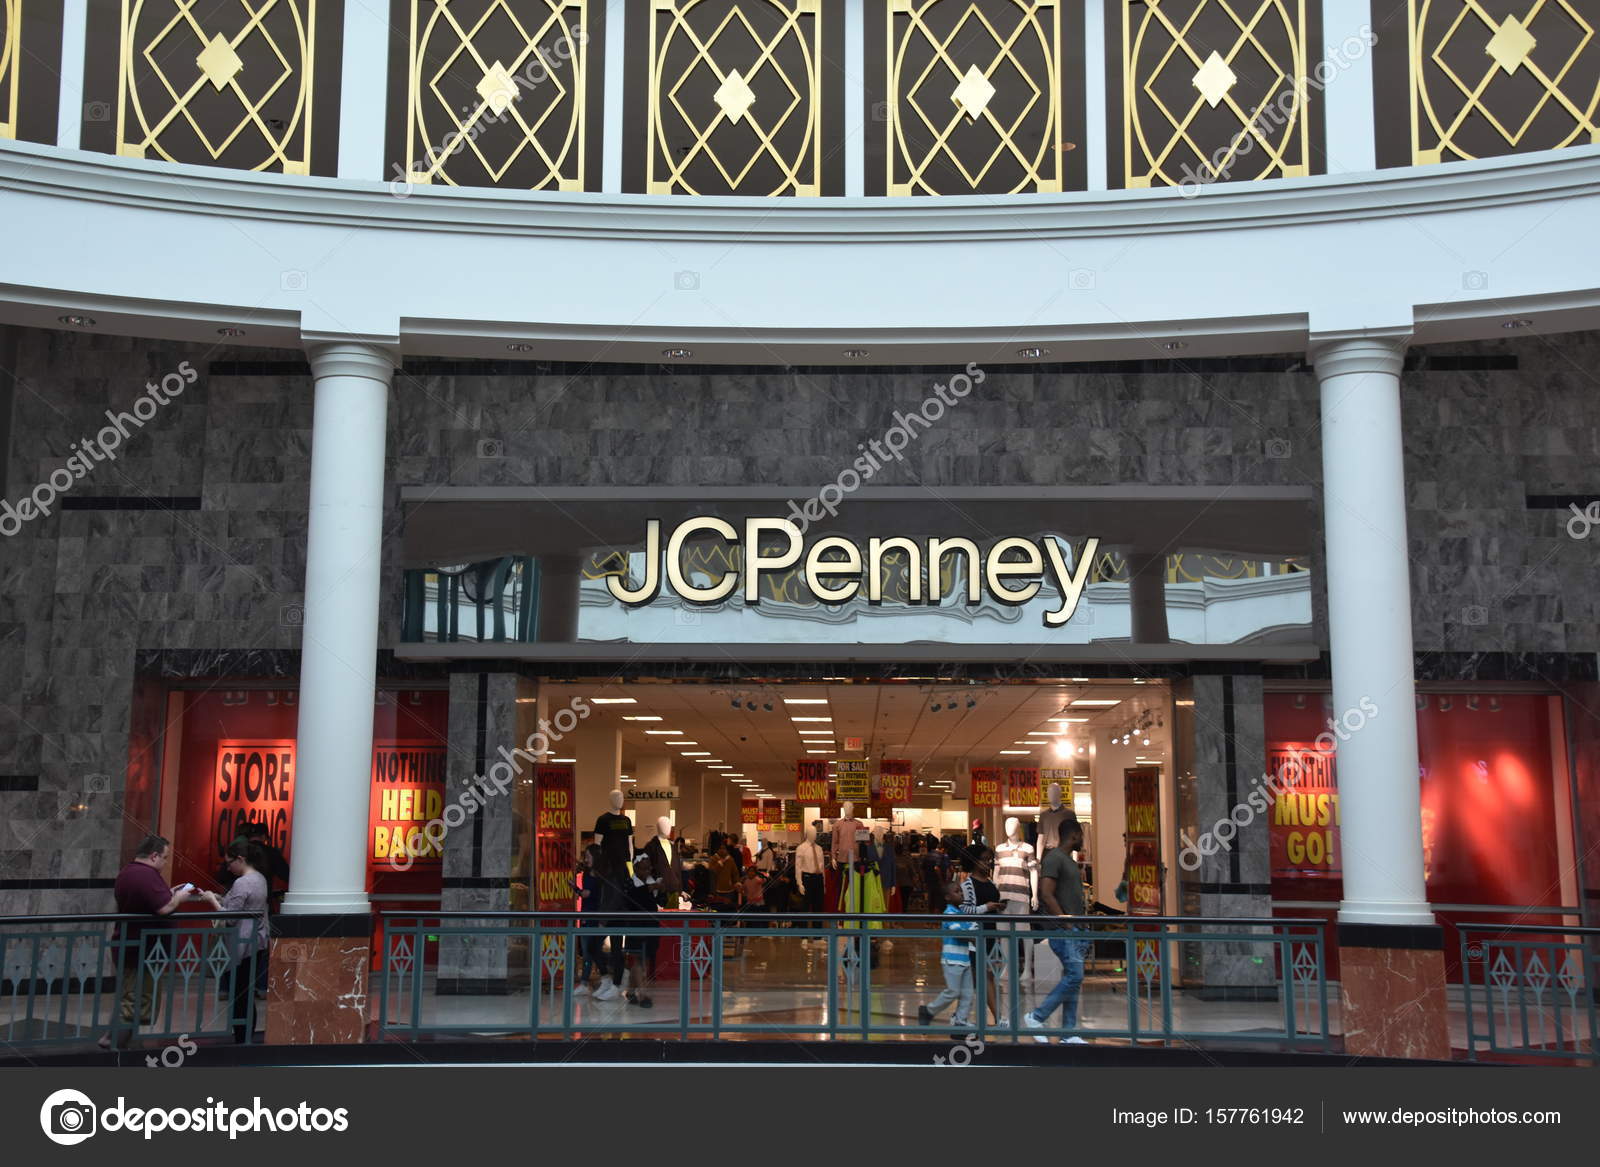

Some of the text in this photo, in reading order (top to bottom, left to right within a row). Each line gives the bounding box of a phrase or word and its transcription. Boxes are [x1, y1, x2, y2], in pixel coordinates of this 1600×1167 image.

[605, 516, 1101, 628] JCPenney
[799, 763, 828, 781] STORE
[838, 762, 850, 772] FOR
[1041, 769, 1071, 779] FOR SALE
[1272, 757, 1338, 788] EVERYTHIN
[219, 752, 291, 802] STORE
[881, 775, 910, 787] MUST
[1010, 770, 1037, 787] STORE
[627, 789, 674, 799] Service
[798, 781, 829, 801] CLOSING
[886, 787, 908, 800] GO!
[976, 782, 997, 793] HELD
[1009, 788, 1039, 805] CLOSING
[382, 789, 443, 821] HELD
[543, 791, 567, 809] HELD
[974, 793, 1000, 805] BACK!
[1128, 804, 1157, 833] CLOSING
[1275, 793, 1342, 826] MUST
[540, 810, 571, 829] BACK!
[217, 808, 288, 857] CLNG
[1287, 831, 1334, 864] GO!
[1129, 865, 1157, 883] MUST
[539, 872, 574, 901] CLOSING
